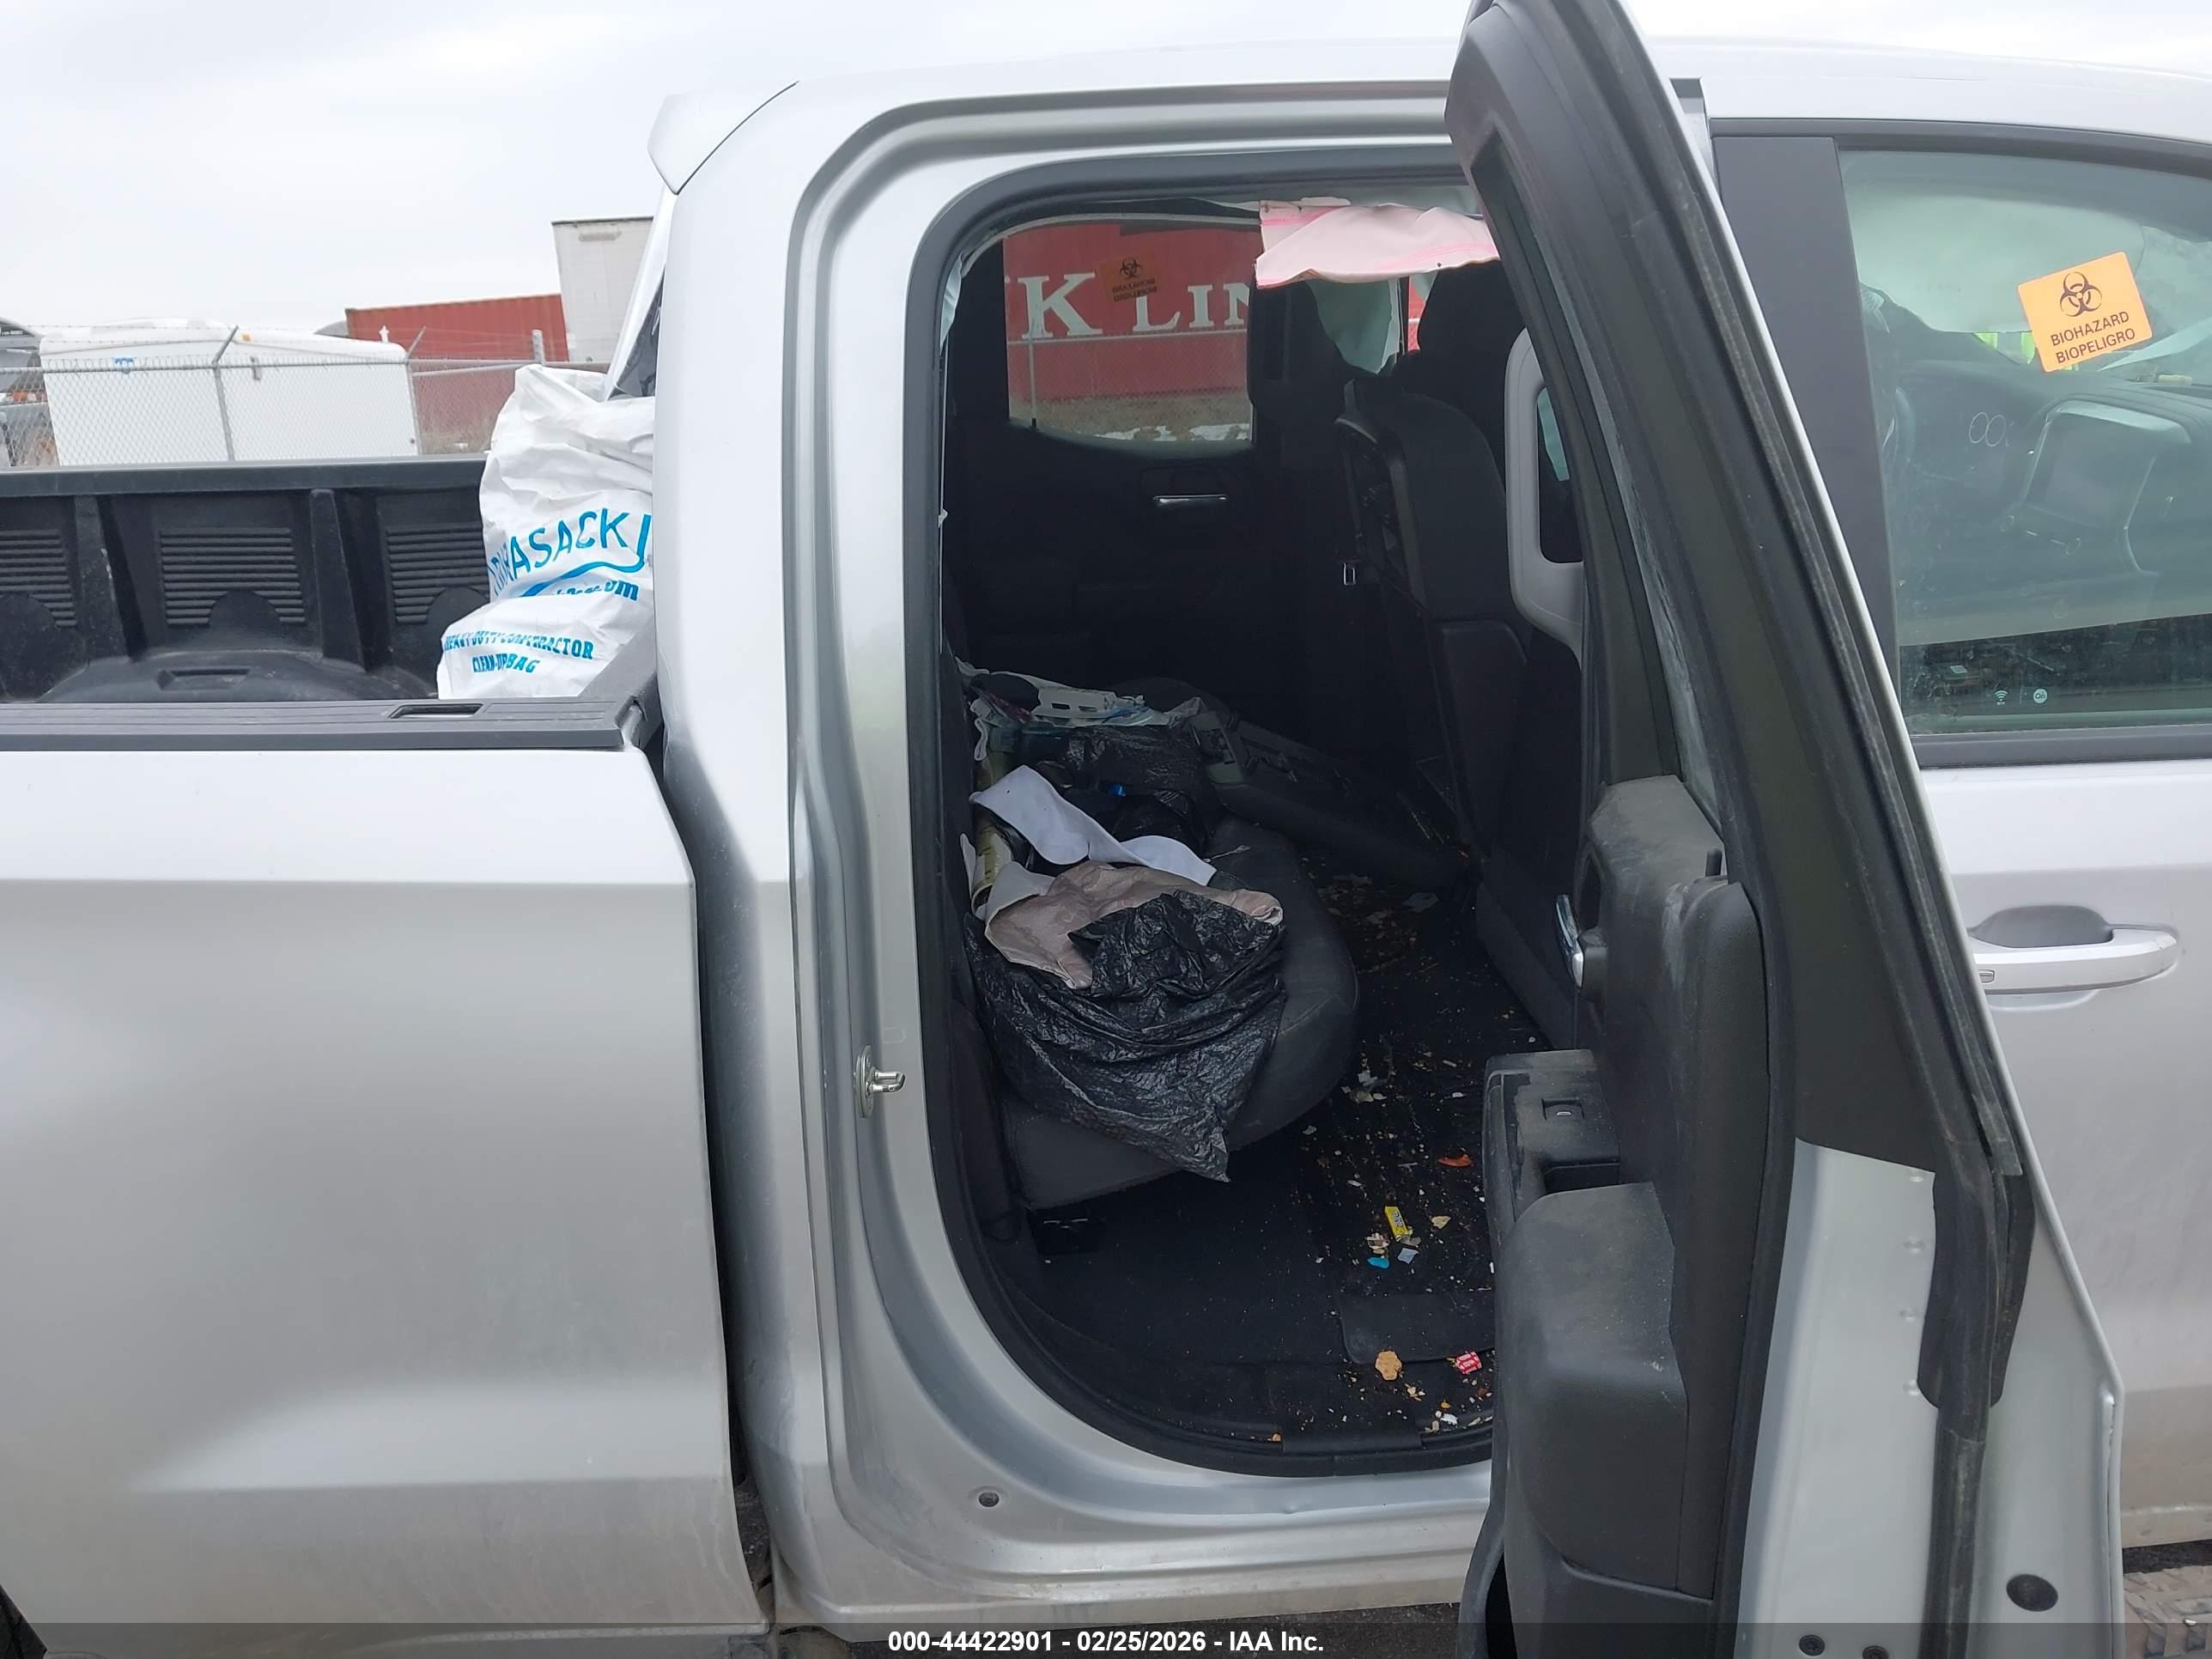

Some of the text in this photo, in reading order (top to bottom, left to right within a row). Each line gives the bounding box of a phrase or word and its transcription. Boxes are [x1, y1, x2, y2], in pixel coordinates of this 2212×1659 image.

[2050, 311, 2130, 347] BIOHAZARD
[2055, 328, 2136, 364] BIOPELIGRO
[505, 653, 541, 673] BAG
